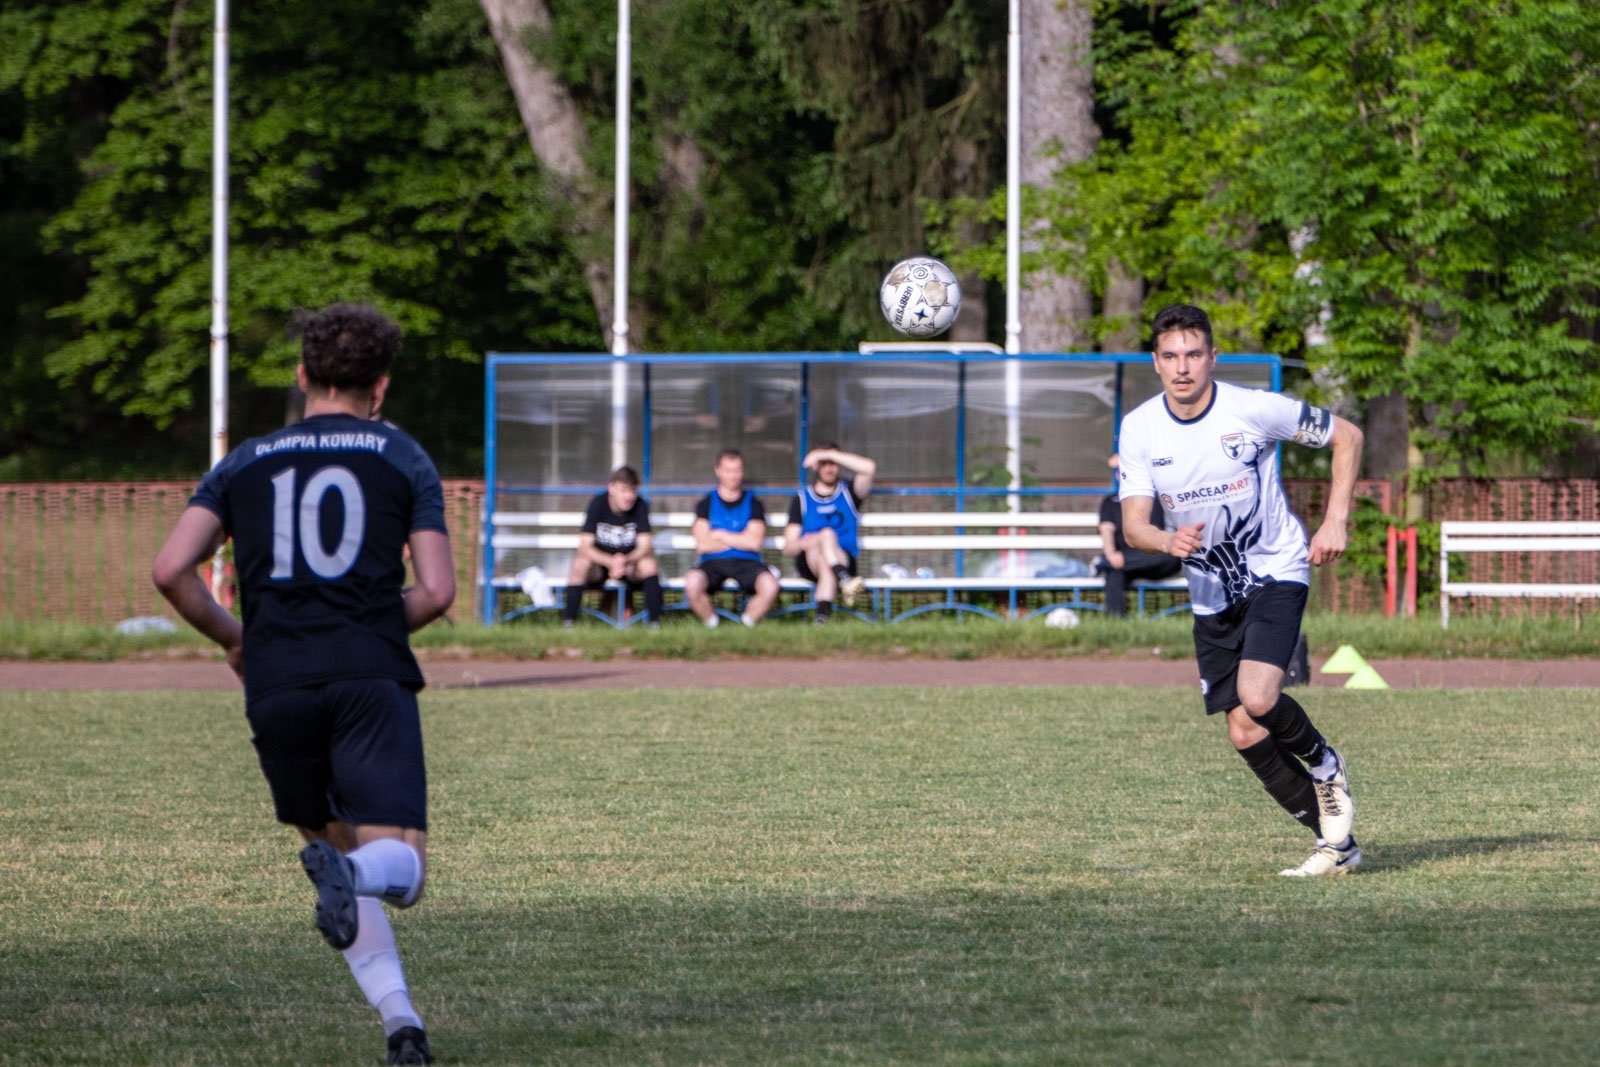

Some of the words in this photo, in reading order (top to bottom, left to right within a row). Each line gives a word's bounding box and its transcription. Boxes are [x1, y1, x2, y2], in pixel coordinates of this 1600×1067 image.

[895, 286, 914, 326] DERBYSTAR
[255, 435, 316, 455] OLIMPIA
[319, 433, 387, 453] KOWARY
[1177, 477, 1249, 503] SPACEAPART
[270, 465, 365, 579] 10
